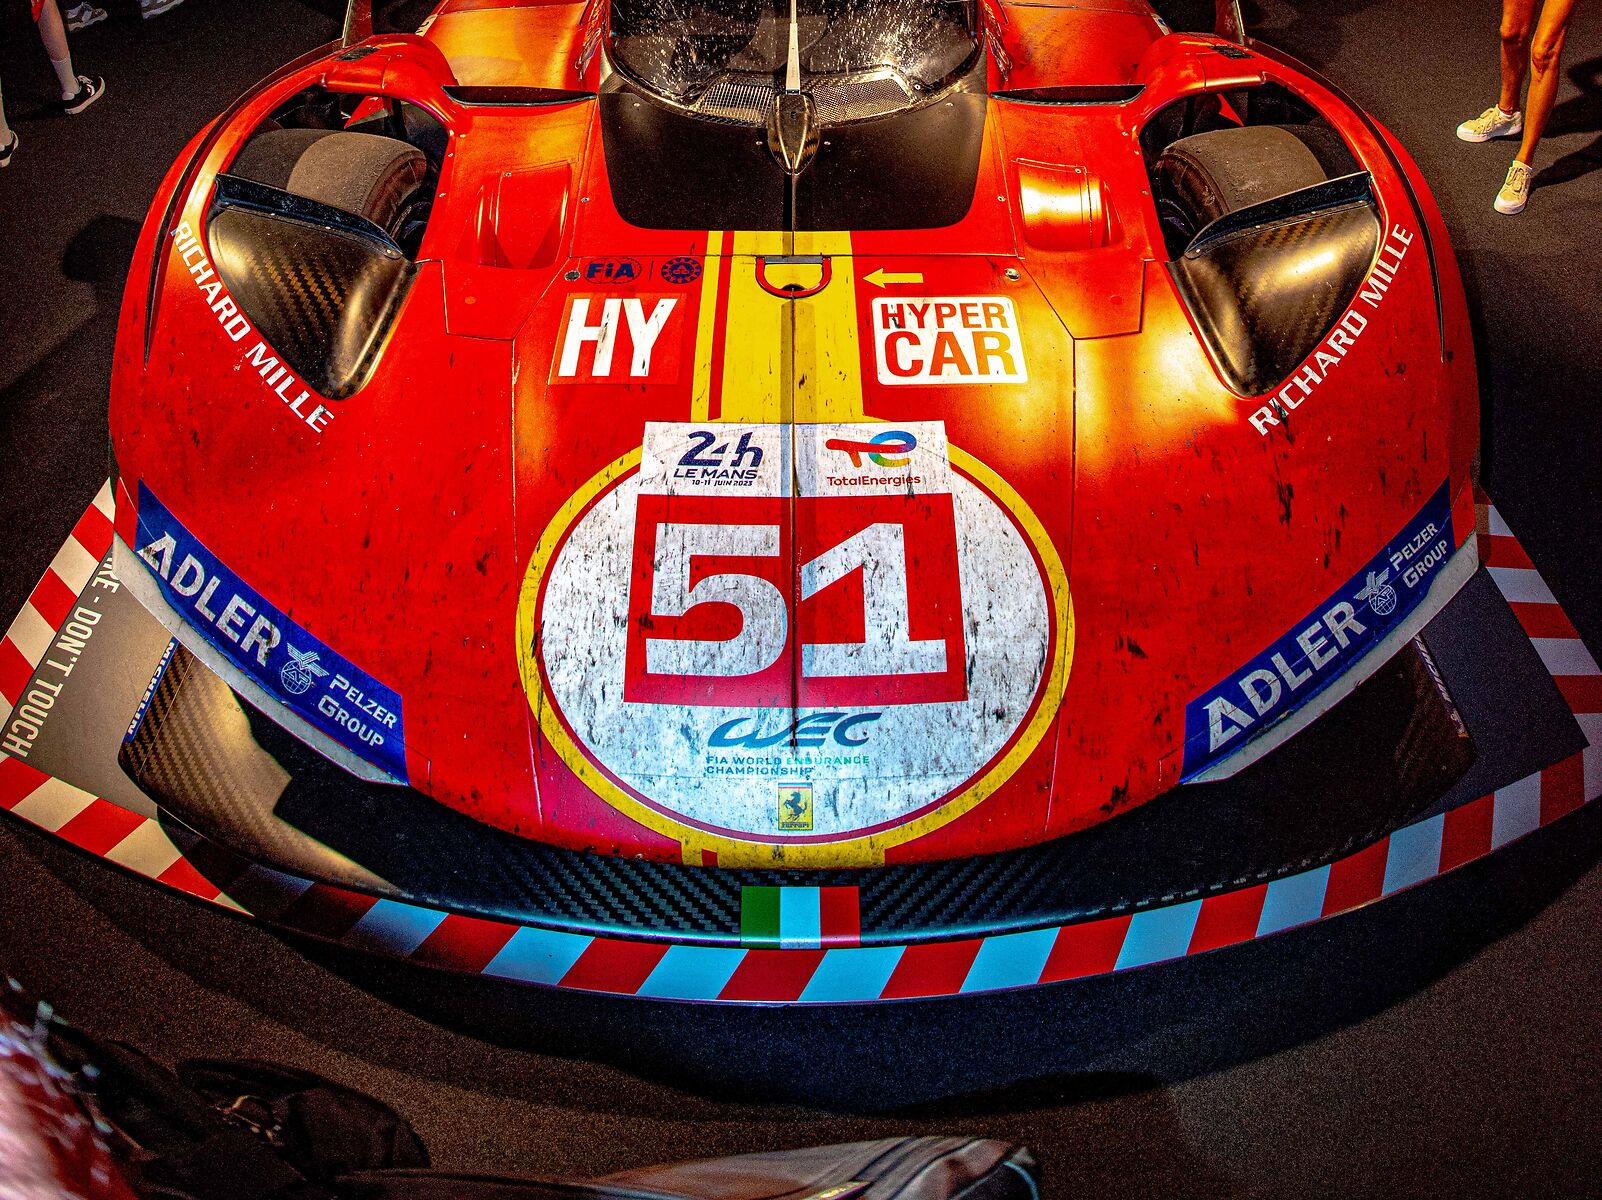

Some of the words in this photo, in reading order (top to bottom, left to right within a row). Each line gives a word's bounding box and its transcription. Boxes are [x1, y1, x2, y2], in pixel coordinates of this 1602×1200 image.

[174, 220, 251, 342] RICHARD
[245, 341, 335, 434] MILLE
[557, 297, 679, 377] HY
[880, 302, 1009, 329] HYPER
[1248, 309, 1368, 437] RICHARD
[1359, 223, 1414, 309] MILLE
[884, 330, 1018, 378] CAR
[673, 468, 698, 480] LE
[700, 468, 758, 480] MANS
[826, 475, 921, 488] TotalEnergies
[1389, 522, 1438, 572] PELZER
[1402, 539, 1448, 589] GROUP
[136, 531, 281, 667] ADLER
[646, 522, 948, 678] 51
[46, 606, 102, 677] DON'T
[127, 641, 175, 735] MICHELIN
[328, 674, 398, 730] PELZER
[1203, 601, 1367, 753] ADLER
[2, 678, 64, 758] TOUCH
[318, 694, 384, 747] GROUP
[707, 711, 883, 749] WEC
[706, 755, 728, 765] FIA
[732, 755, 782, 765] WORLD
[786, 755, 870, 765] ENDURANCE
[706, 766, 812, 776] CHAMPIONSHIP
